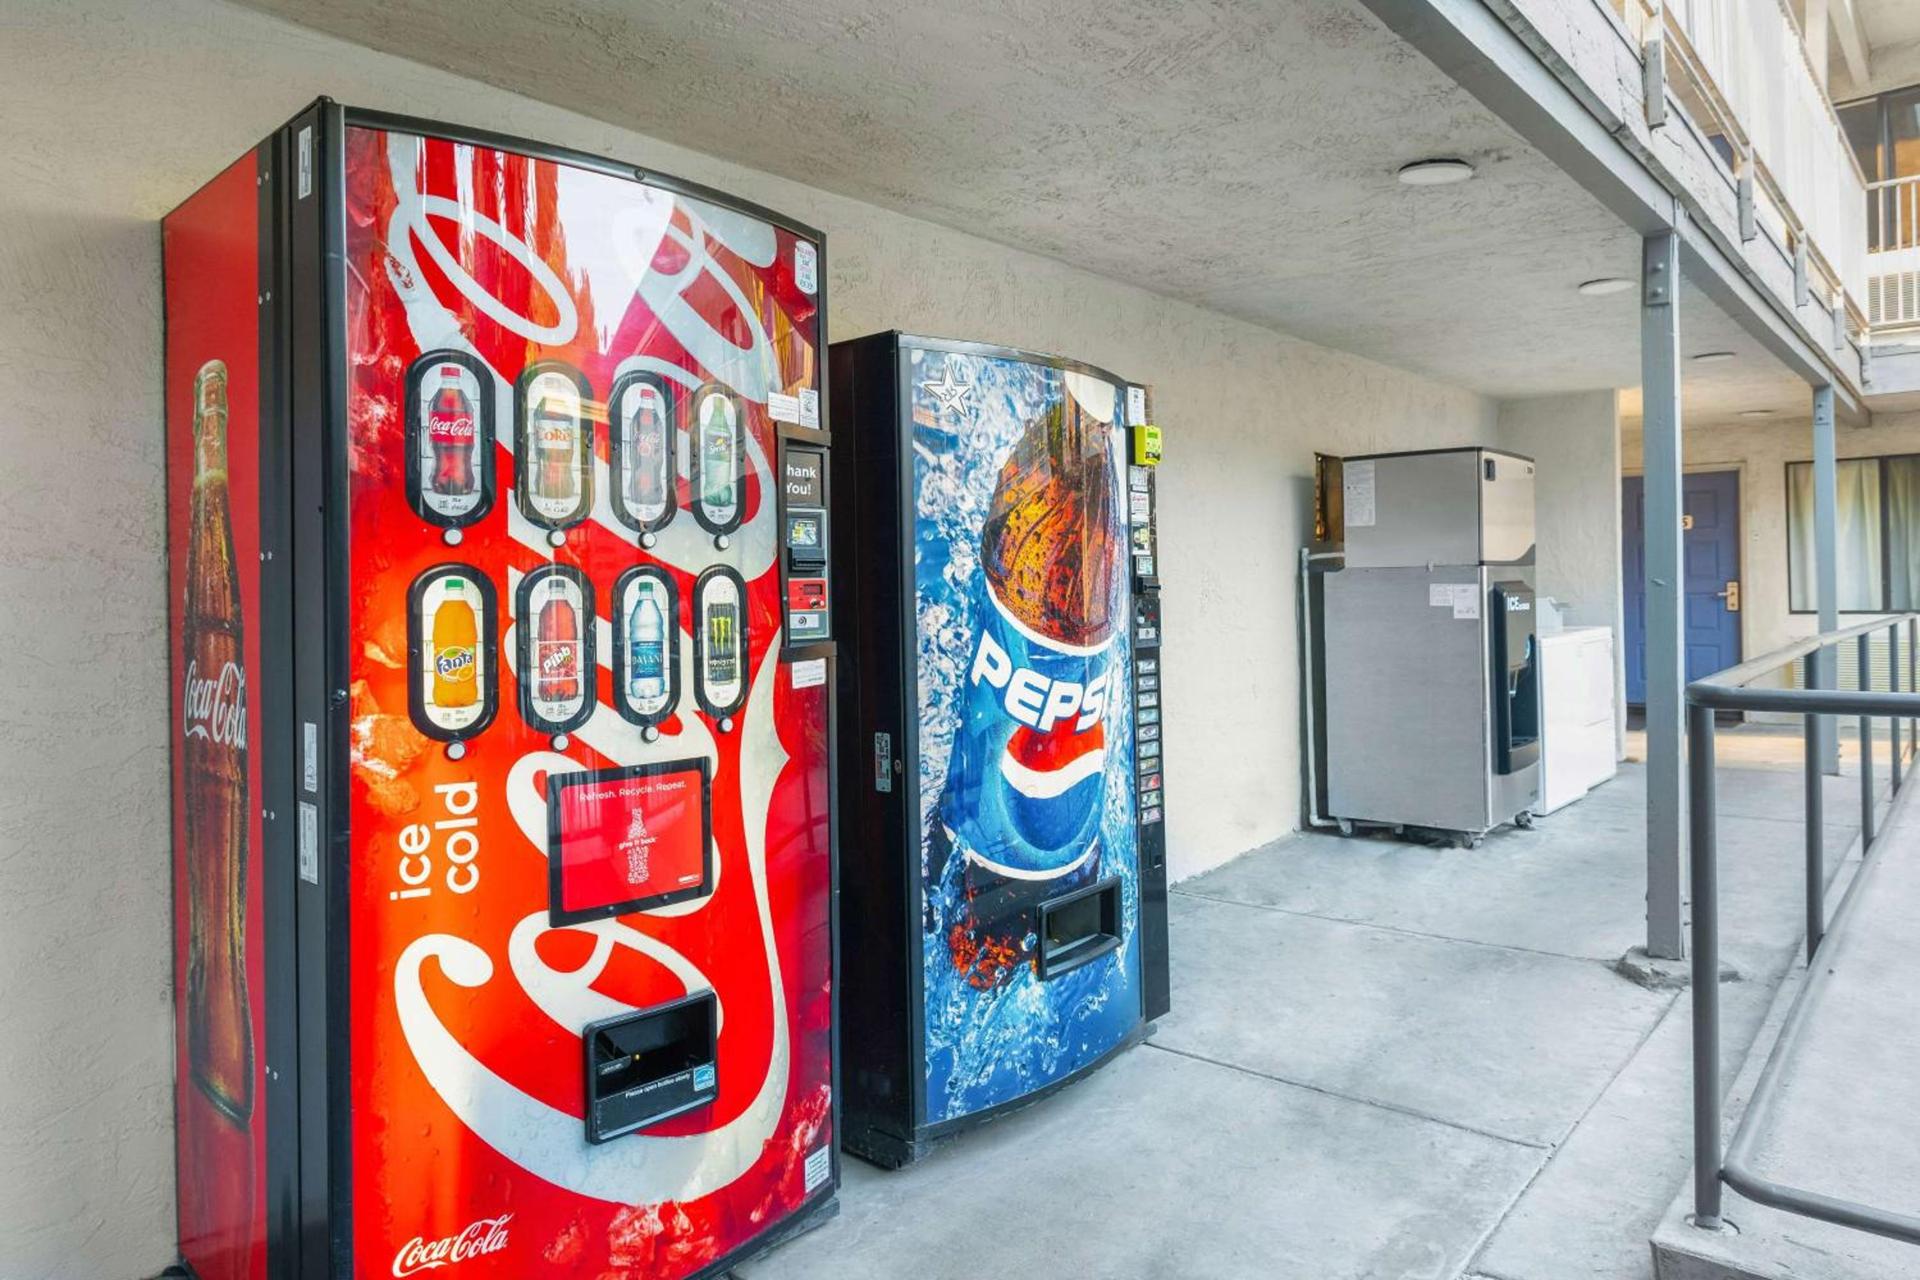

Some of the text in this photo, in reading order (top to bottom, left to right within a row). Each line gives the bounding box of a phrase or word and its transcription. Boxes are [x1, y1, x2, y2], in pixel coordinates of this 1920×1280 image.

[430, 416, 473, 436] Coca-Cola
[787, 464, 817, 478] hank
[543, 646, 571, 674] Pibb
[184, 660, 247, 750] Coca-Cola
[390, 824, 432, 900] ice
[434, 781, 480, 894] cold
[392, 1213, 515, 1278] Coca-Cola
